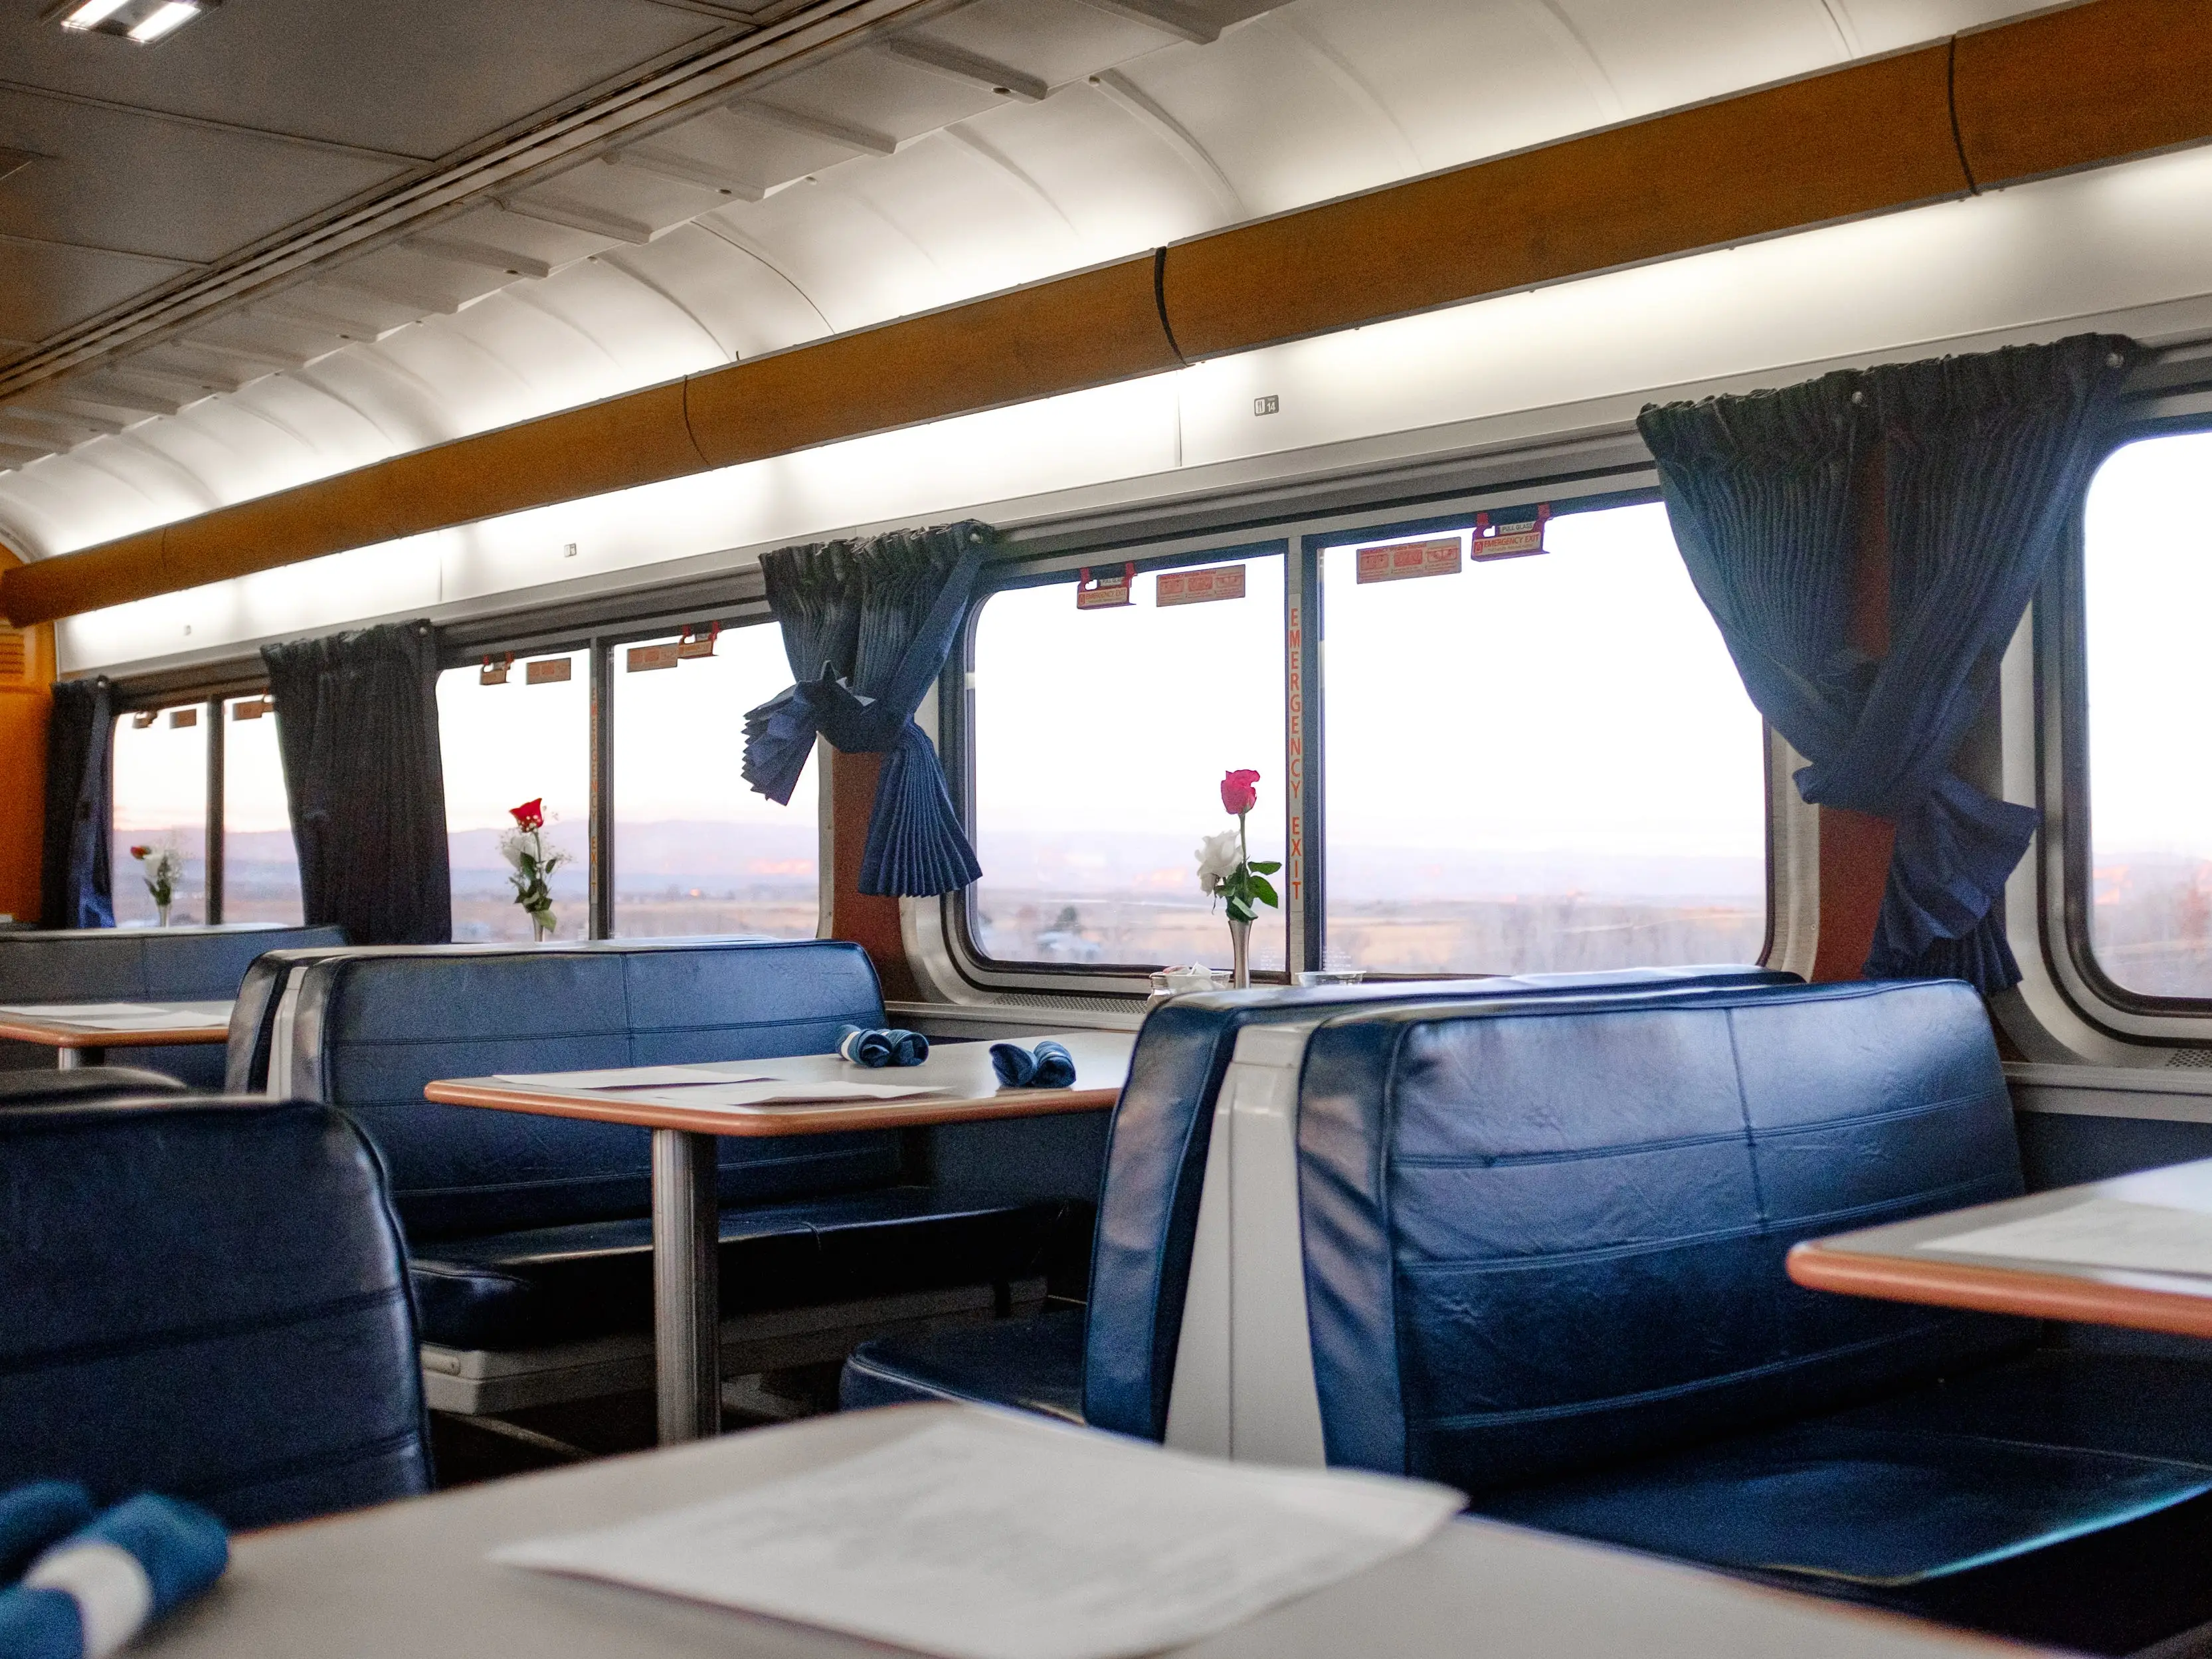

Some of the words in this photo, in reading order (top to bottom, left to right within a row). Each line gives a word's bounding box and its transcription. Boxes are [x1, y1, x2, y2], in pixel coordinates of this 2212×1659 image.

[1267, 401, 1276, 412] 14
[1484, 536, 1523, 547] EMERGENCY
[1525, 534, 1539, 543] EXIT
[1289, 608, 1301, 799] EMERGENCY
[1291, 816, 1301, 900] EXIT
